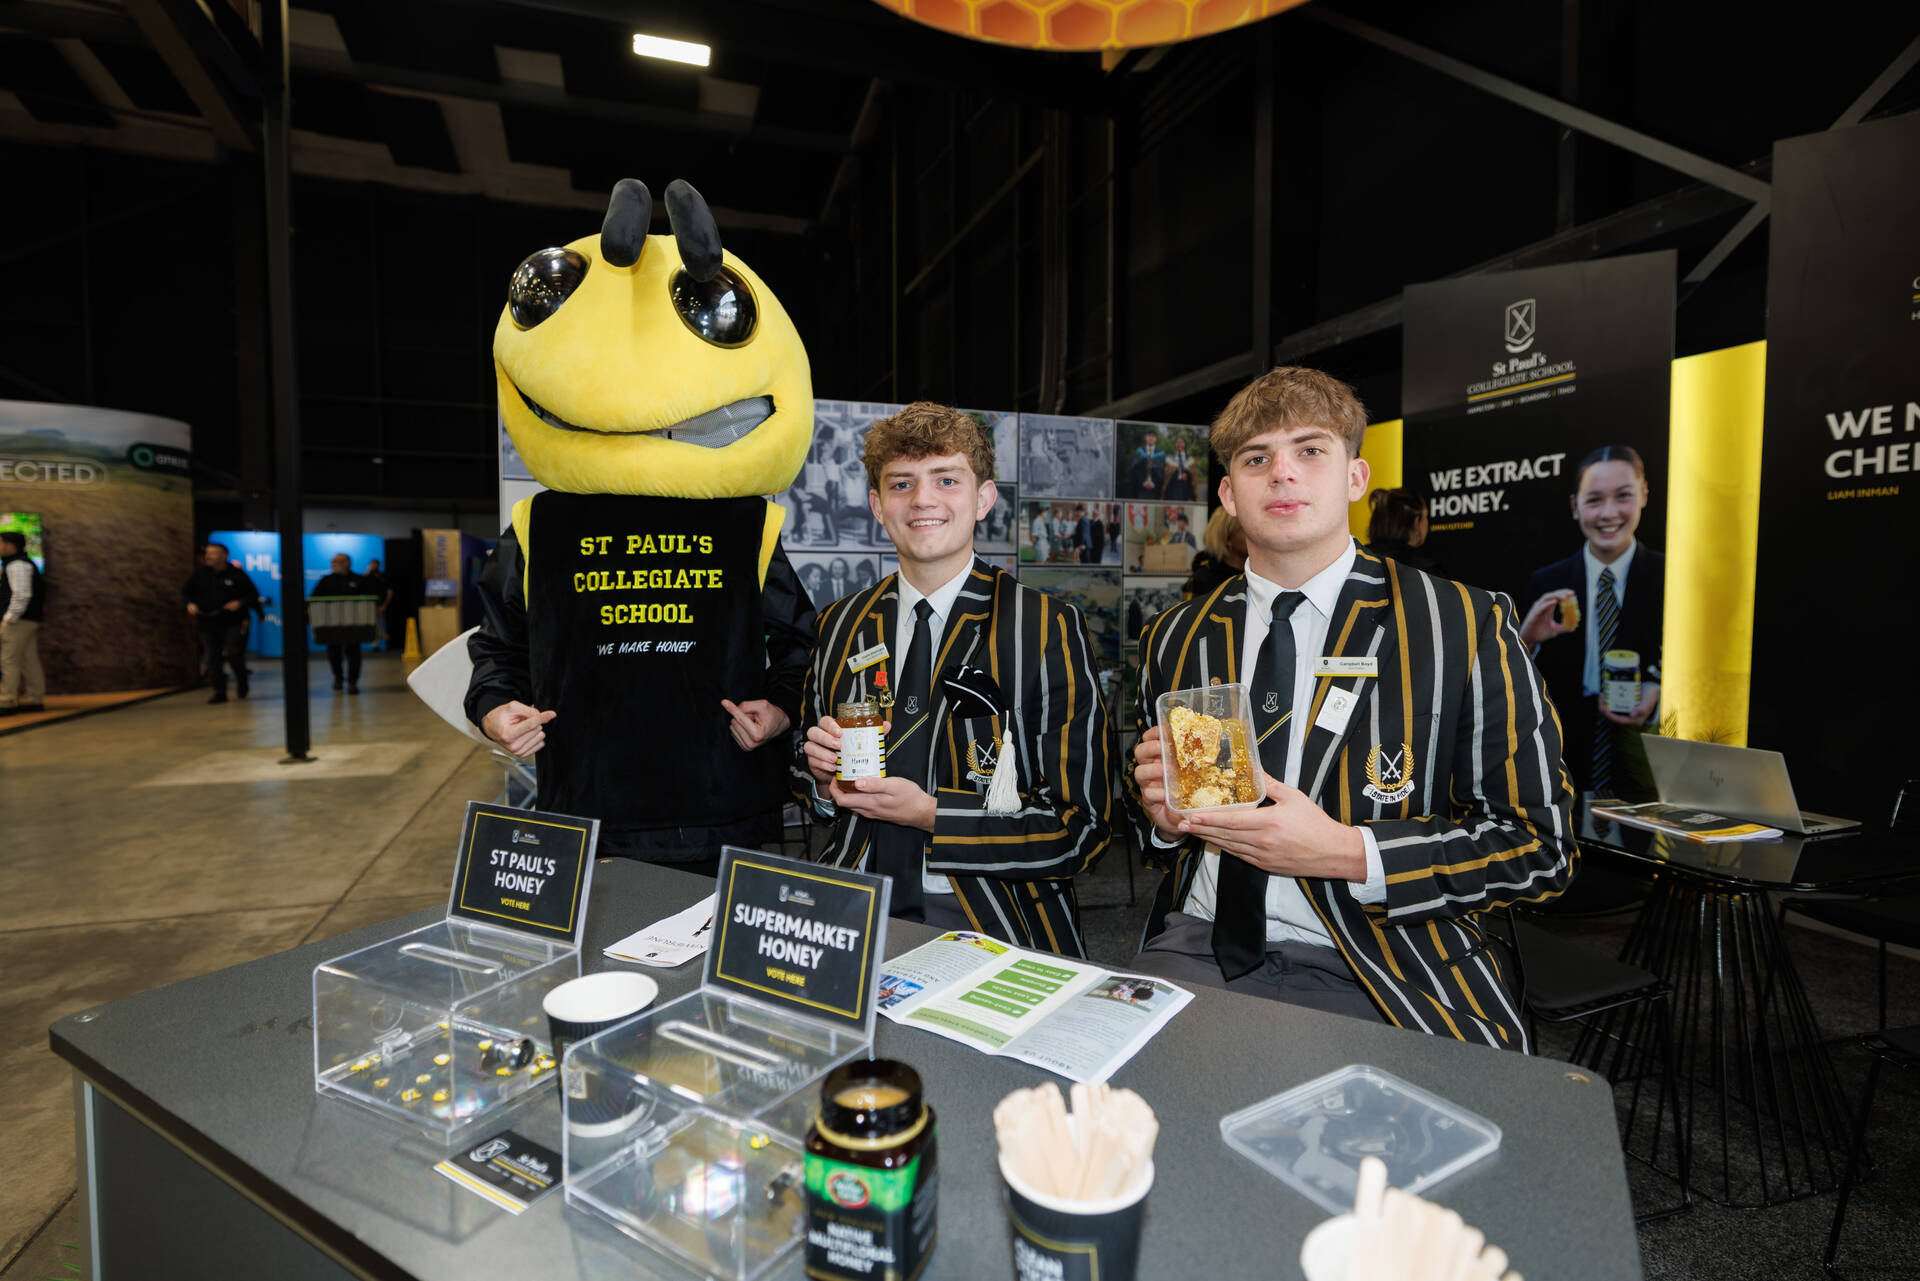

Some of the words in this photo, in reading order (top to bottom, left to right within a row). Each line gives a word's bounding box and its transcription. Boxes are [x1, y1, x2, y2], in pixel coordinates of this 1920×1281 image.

[1508, 351, 1547, 373] Paul's
[1824, 404, 1894, 440] WE
[1430, 468, 1462, 492] WE
[1465, 452, 1566, 488] EXTRACT
[1430, 489, 1510, 518] HONEY.
[1827, 489, 1855, 501] LIAM
[1856, 485, 1900, 498] INMAN
[580, 536, 613, 556] ST
[625, 533, 714, 555] PAUL'S
[573, 568, 724, 593] COLLEGIATE
[600, 603, 694, 625] SCHOOL
[618, 640, 652, 654] MAKE
[1371, 790, 1389, 802] STATE
[490, 848, 508, 867] ST
[508, 852, 557, 877] PAUL'S
[494, 870, 545, 896] HONEY
[500, 897, 516, 908] VOTE
[515, 900, 531, 911] HERE
[733, 902, 860, 952] SUPERMARKET
[757, 933, 824, 970] HONEY
[766, 966, 786, 982] VOTE
[785, 972, 806, 988] HERE
